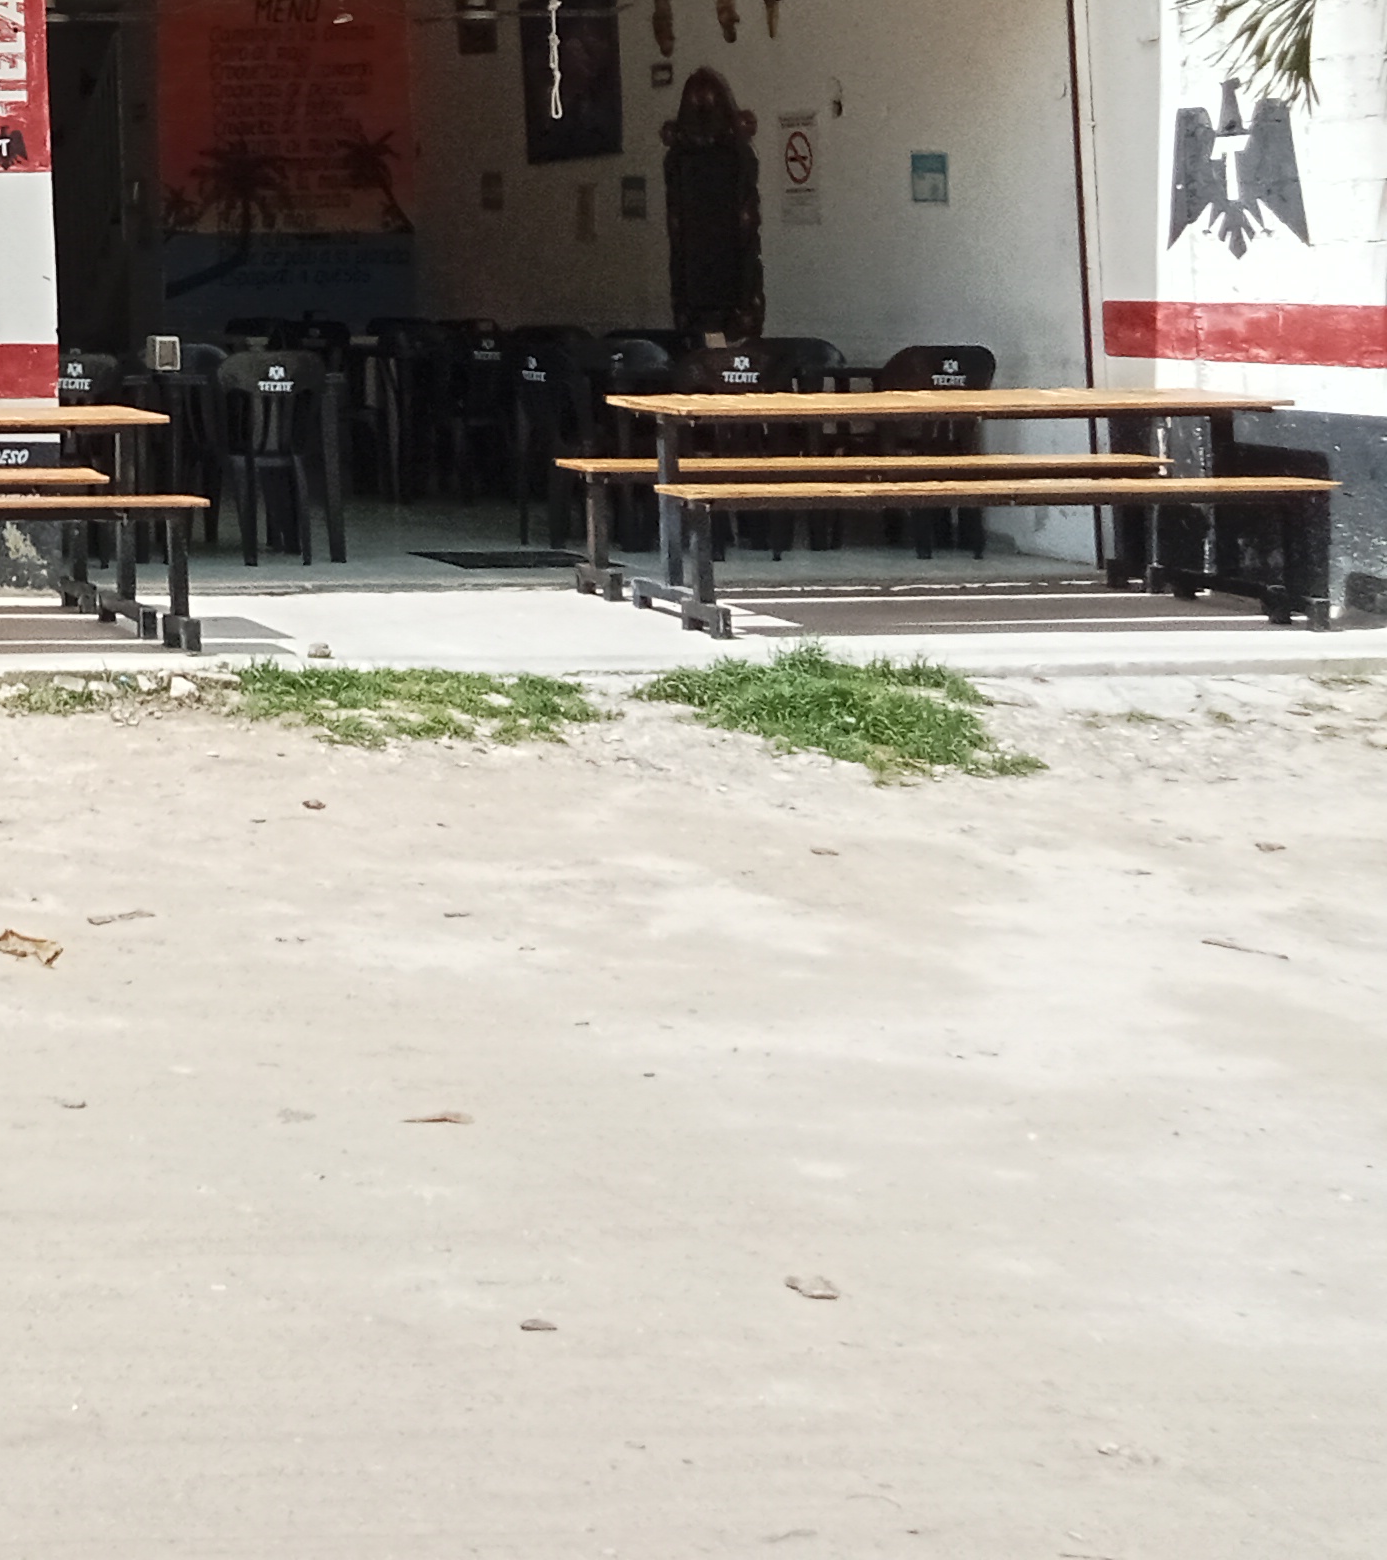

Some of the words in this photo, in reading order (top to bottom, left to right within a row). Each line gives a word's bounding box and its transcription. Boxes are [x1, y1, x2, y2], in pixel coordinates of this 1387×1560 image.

[722, 371, 760, 384] TECATE
[931, 374, 967, 387] TECATE
[257, 381, 295, 392] TECATE
